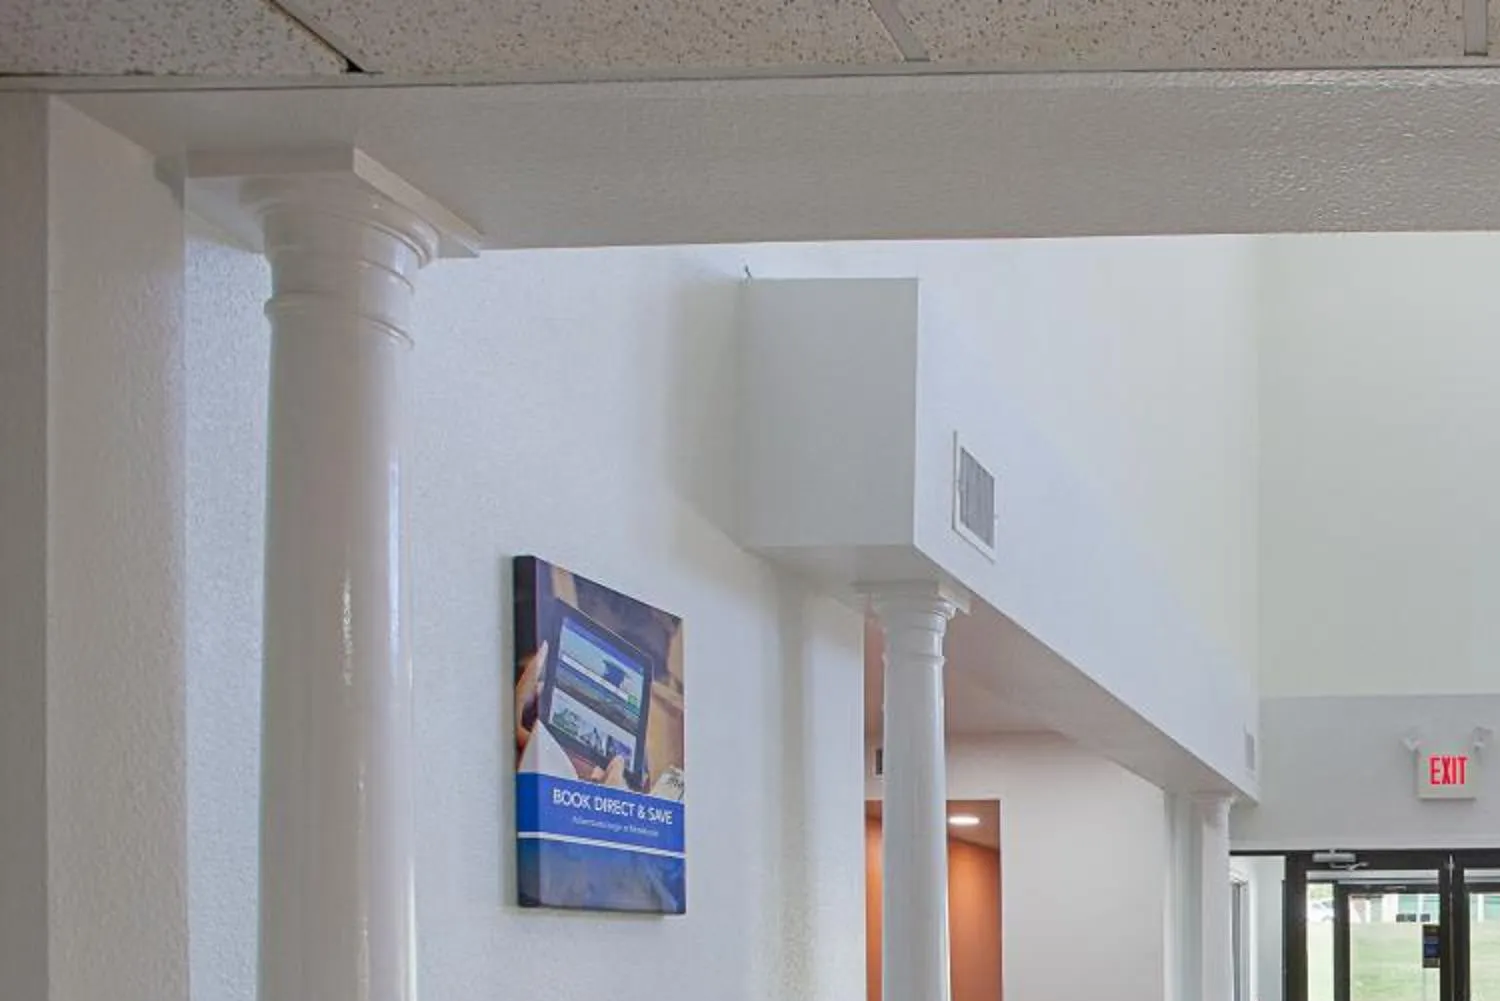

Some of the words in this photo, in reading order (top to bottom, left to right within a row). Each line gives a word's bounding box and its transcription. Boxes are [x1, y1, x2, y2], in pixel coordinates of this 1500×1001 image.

[1428, 754, 1469, 786] EXIT
[553, 787, 591, 811] BOOK
[594, 796, 636, 816] DIRECT
[637, 803, 646, 819] &
[647, 807, 673, 825] SAVE
